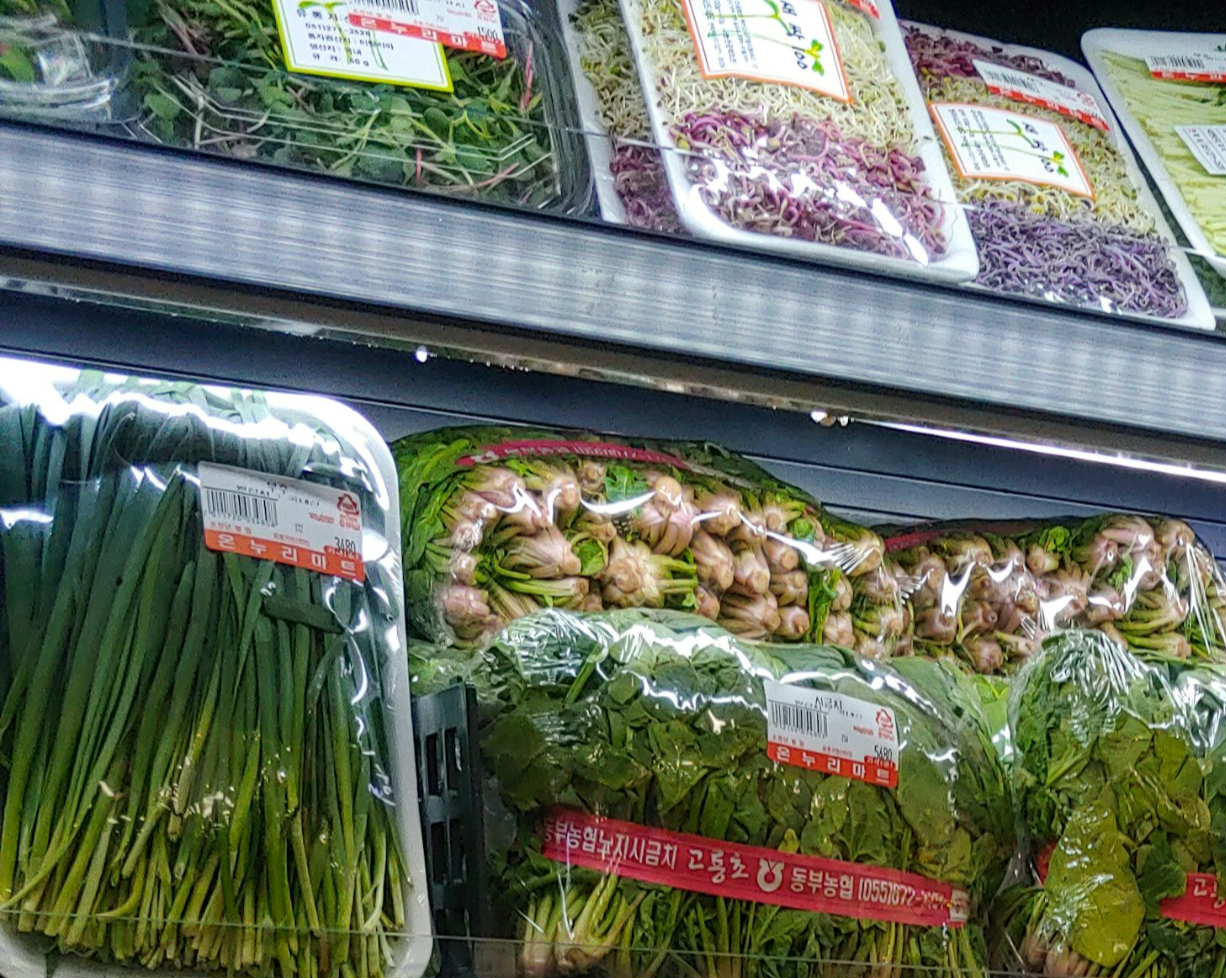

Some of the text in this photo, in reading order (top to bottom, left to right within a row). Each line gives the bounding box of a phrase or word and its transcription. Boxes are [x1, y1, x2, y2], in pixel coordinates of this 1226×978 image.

[217, 534, 357, 577] 온누리마트
[776, 746, 890, 784] 온누리마트
[790, 866, 854, 900] 동부농협
